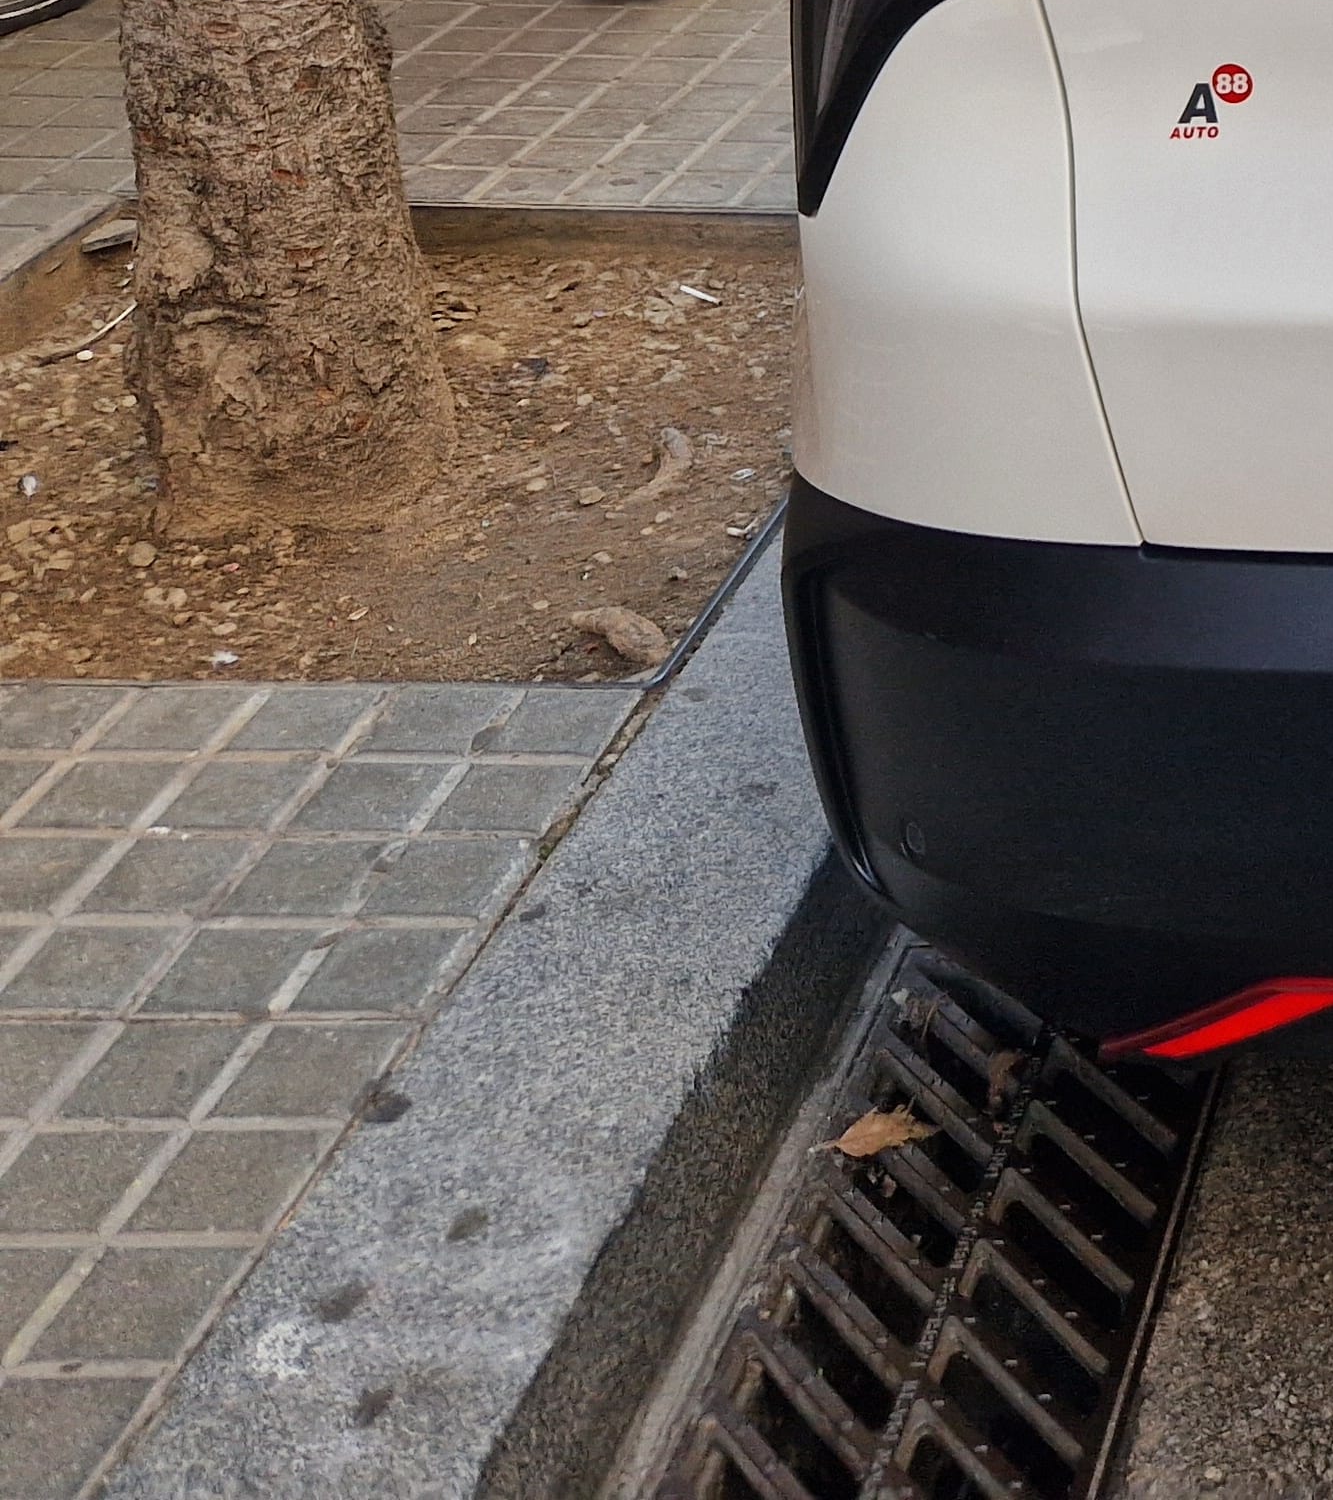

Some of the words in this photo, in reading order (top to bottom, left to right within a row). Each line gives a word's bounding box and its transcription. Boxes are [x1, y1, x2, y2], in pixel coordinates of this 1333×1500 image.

[1177, 82, 1219, 124] A
[1216, 72, 1249, 95] 88
[1169, 126, 1220, 140] AUTO
